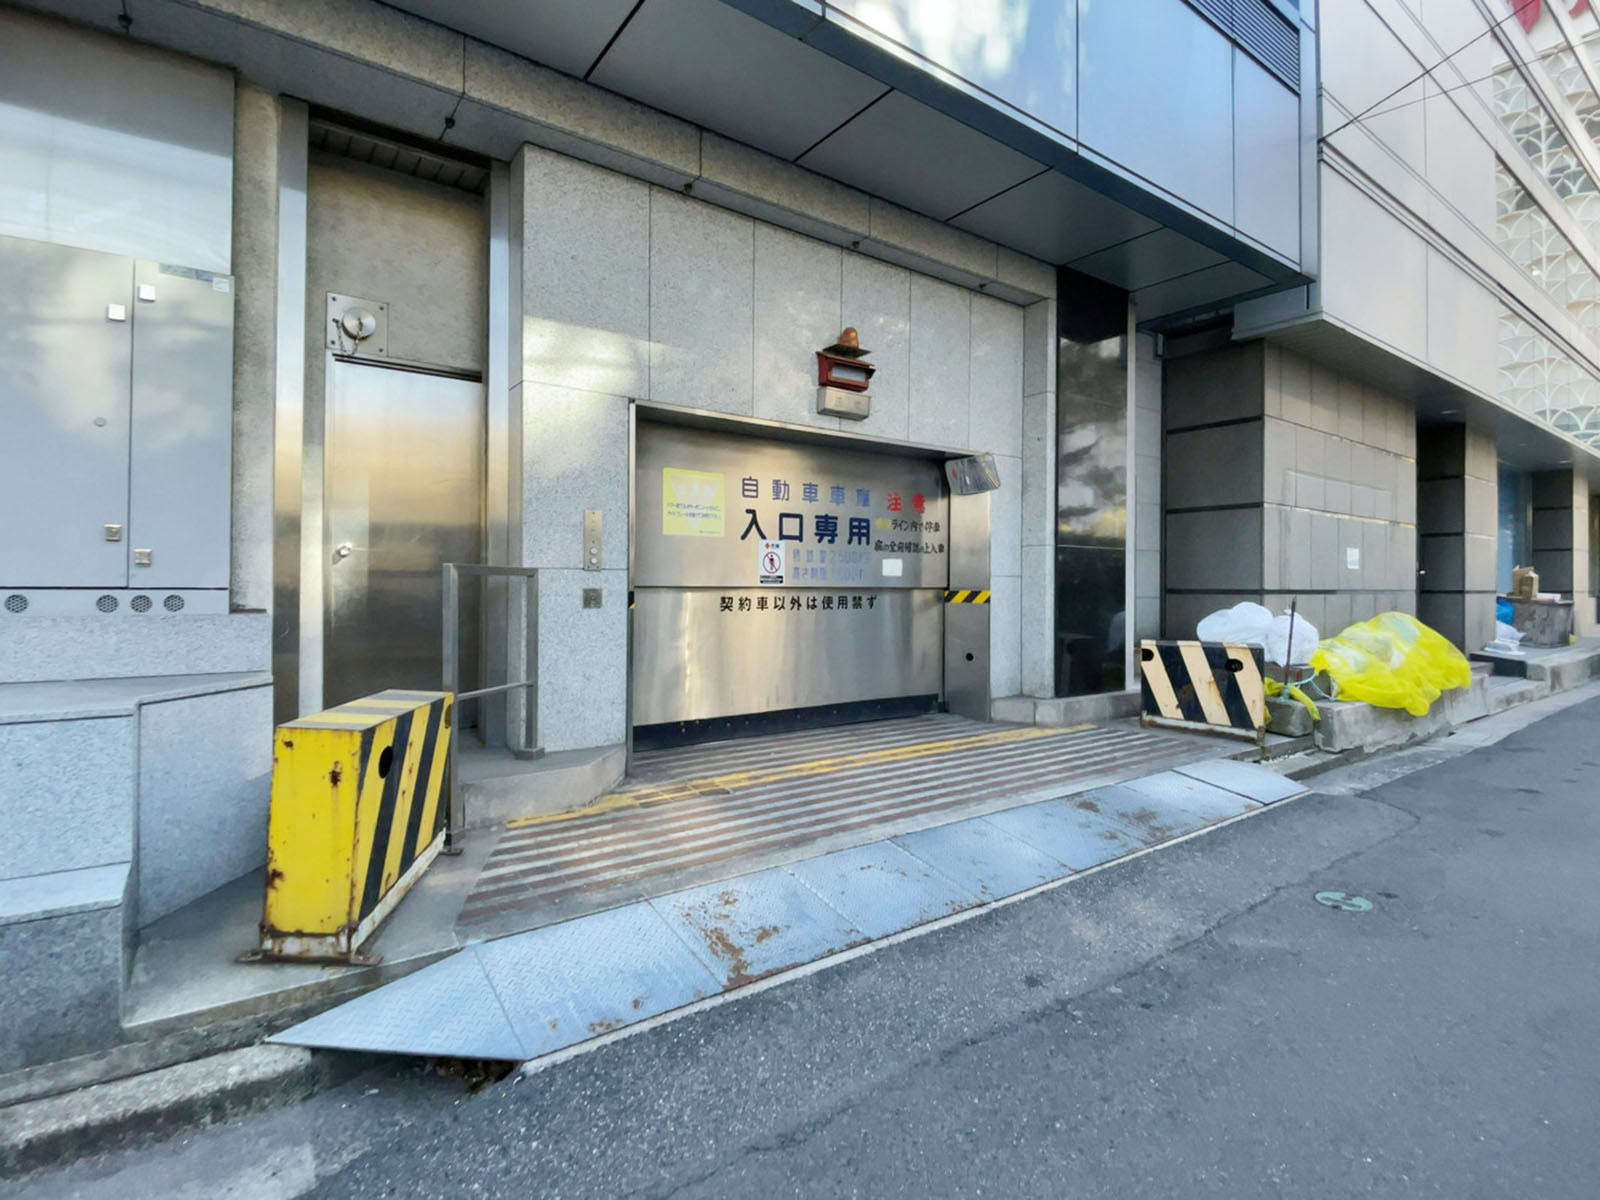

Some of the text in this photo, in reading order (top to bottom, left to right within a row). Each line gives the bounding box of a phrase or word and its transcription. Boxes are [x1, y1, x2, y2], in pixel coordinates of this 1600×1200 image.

[742, 476, 871, 507] 自動車車庫
[886, 491, 926, 514] 注意
[741, 508, 870, 546] 入口専用
[720, 594, 877, 612] 契約車以外は使用禁ず
